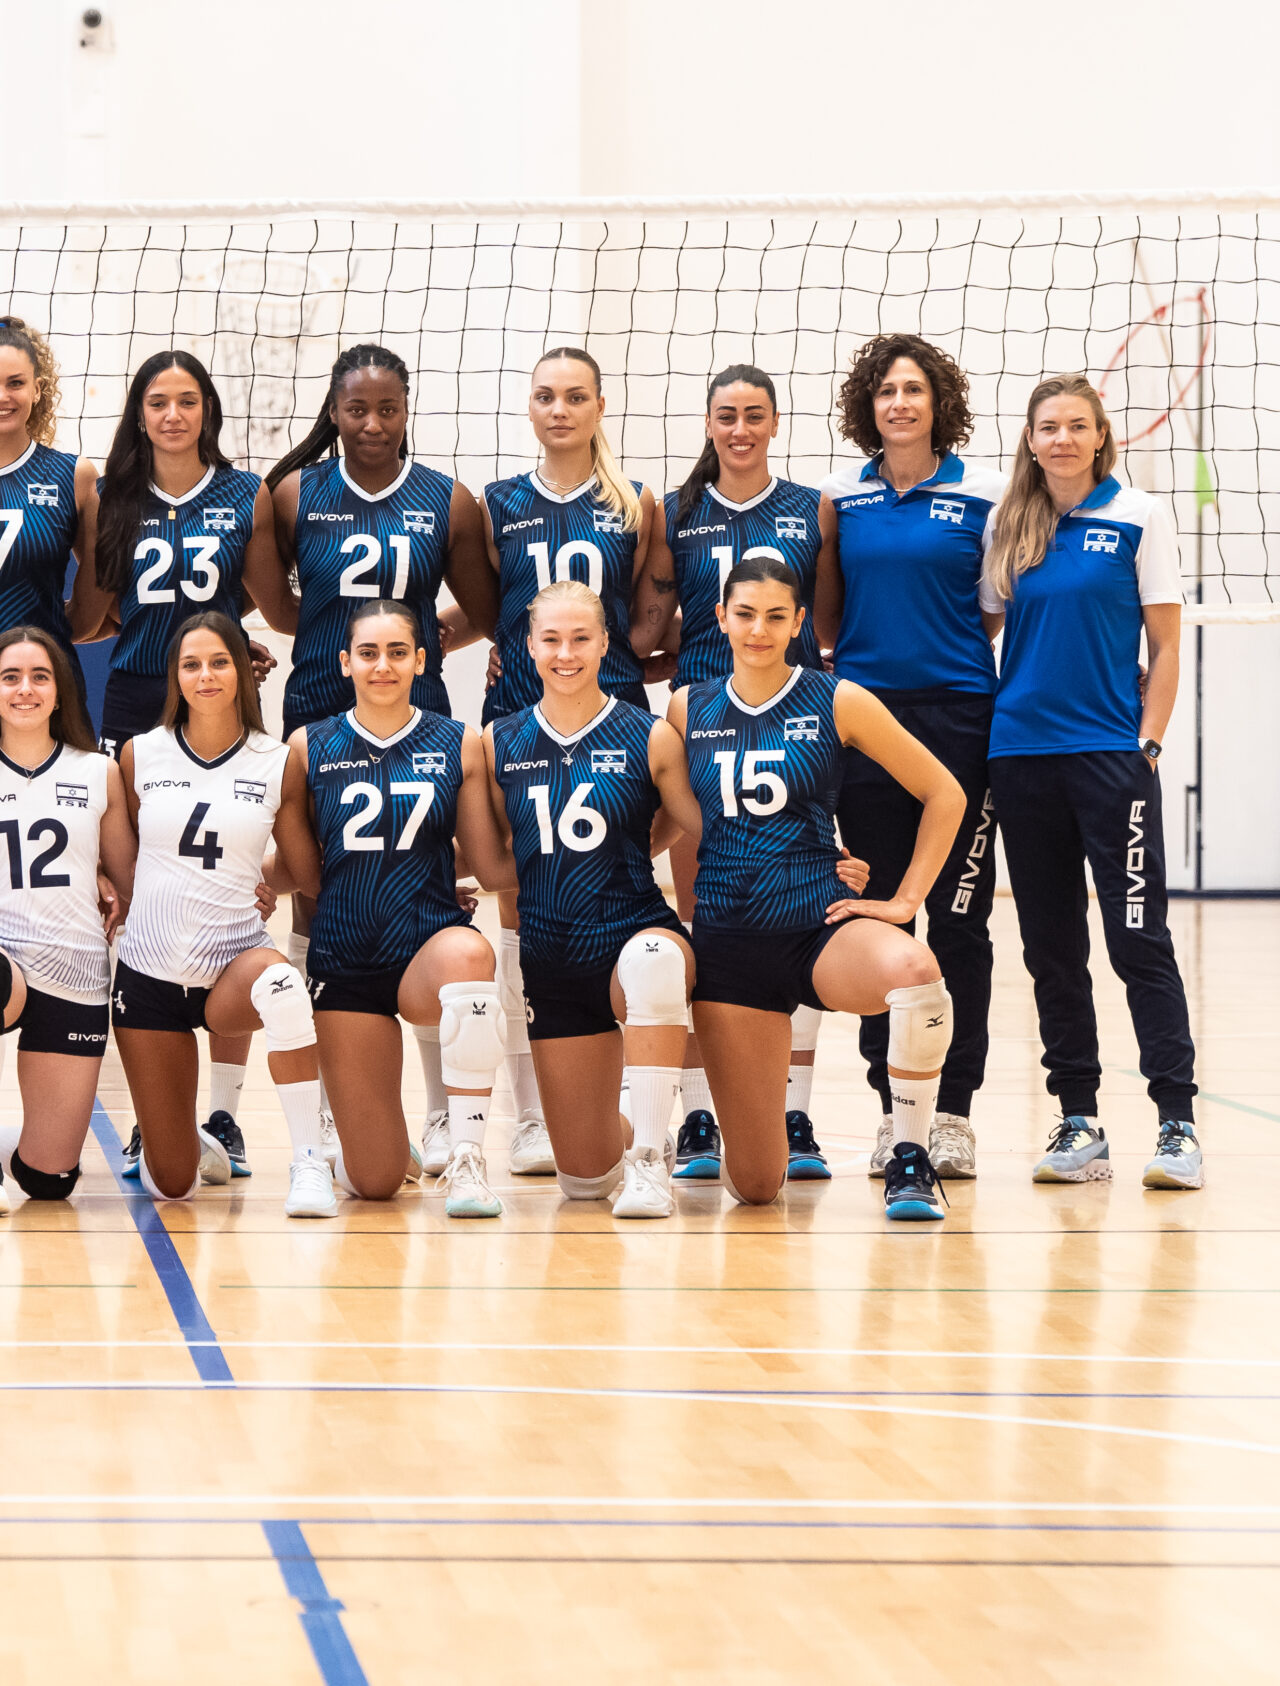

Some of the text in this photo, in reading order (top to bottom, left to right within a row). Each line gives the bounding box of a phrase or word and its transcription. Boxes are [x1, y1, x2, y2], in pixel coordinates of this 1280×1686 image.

[28, 499, 59, 507] ISR
[840, 494, 884, 510] GIVOVA
[307, 512, 354, 522] GIVOVA
[929, 512, 962, 526] ISR
[404, 526, 434, 536] ISR
[502, 517, 544, 534] GIVOVA
[594, 526, 622, 534] ISR
[678, 524, 726, 538] GIVOVA
[777, 531, 807, 541] ISR
[1083, 544, 1117, 555] ISR
[134, 536, 220, 604] 23
[339, 534, 410, 599] 21
[527, 540, 603, 597] 10
[711, 546, 786, 603] 1
[691, 728, 736, 739] GIVOVA
[784, 733, 819, 741] ISR
[319, 760, 369, 773] GIVOVA
[413, 767, 447, 775] ISR
[503, 760, 549, 772] GIVOVA
[591, 766, 626, 774] ISR
[143, 780, 191, 791] GIVOVA
[713, 749, 788, 817] 15
[56, 800, 88, 809] ISR
[234, 794, 265, 805] ISR
[340, 781, 435, 851] 27
[527, 782, 608, 855] 16
[178, 801, 224, 870] 4
[950, 787, 995, 915] GIVOVA
[1125, 800, 1146, 929] GIVOVA
